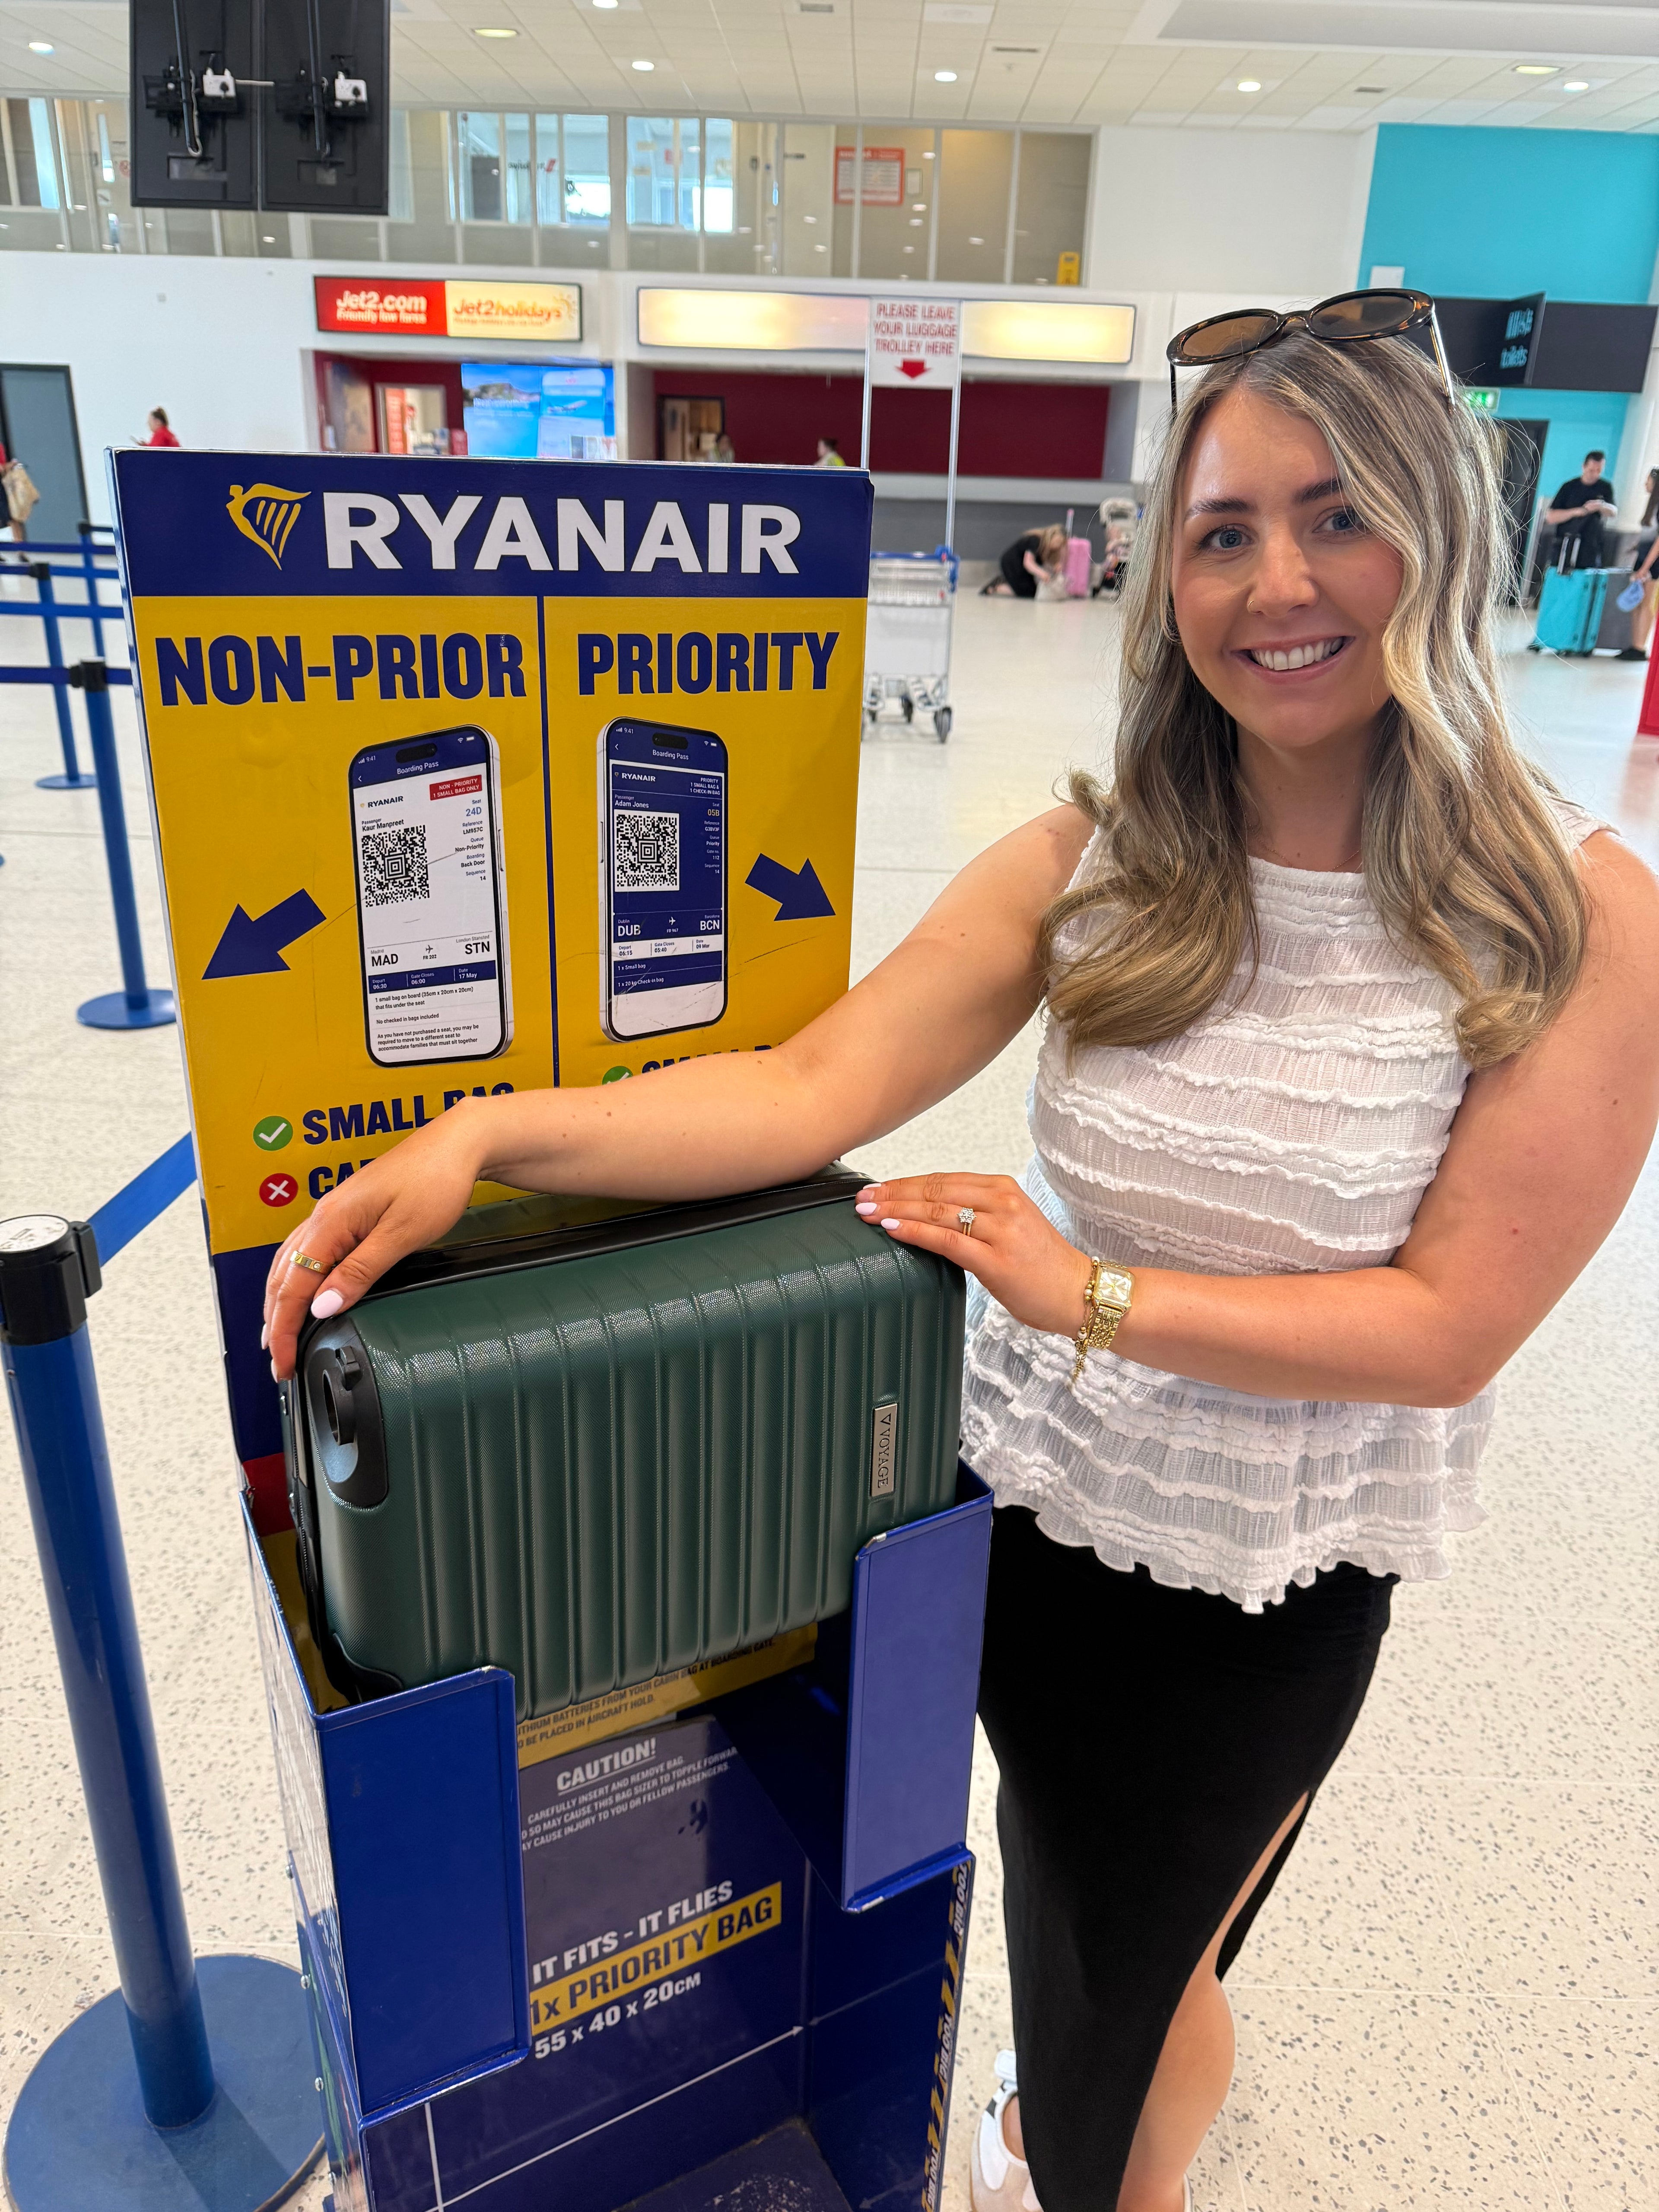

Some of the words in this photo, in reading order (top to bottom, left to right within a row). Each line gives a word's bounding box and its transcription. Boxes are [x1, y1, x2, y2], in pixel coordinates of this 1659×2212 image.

[336, 291, 427, 311] Jet2.com
[454, 299, 562, 321] Jet2holidays
[877, 303, 917, 318] PLEASE
[922, 305, 955, 320] LEAVE
[874, 321, 903, 335] YOUR
[906, 323, 958, 337] LUGGAGE
[875, 339, 922, 353] TROLLEY
[925, 341, 954, 355] HERE
[322, 492, 801, 574] RYANAIR
[155, 633, 527, 707] NON-PRIOR
[577, 630, 840, 697] PRIORITY
[653, 750, 675, 759] Boarding
[397, 765, 423, 774] Boarding
[622, 773, 656, 782] RYANAIR
[454, 779, 477, 788] PRIORITY
[368, 796, 404, 807] RYANAIR
[466, 807, 482, 817] 24D
[377, 820, 404, 830] Manpreet
[455, 843, 484, 852] Non-Priority
[618, 925, 641, 936] DUB
[700, 920, 720, 930] BCN
[465, 941, 490, 954] STN
[372, 954, 398, 966] MAD
[303, 1095, 435, 1145] SMALL
[557, 1737, 656, 1791] CAUTION!
[528, 1798, 577, 1824] CAREFULLY
[578, 1785, 610, 1805] INSERT
[611, 1778, 629, 1792] AND
[630, 1762, 665, 1785] REMOVE
[666, 1756, 683, 1770] BAG
[957, 1863, 967, 1901] TOO
[953, 1901, 963, 1936] BIG
[533, 1956, 558, 1983] IT
[564, 1930, 619, 1971] FITS
[624, 1930, 633, 1939] -
[639, 1910, 663, 1937] IT
[668, 1880, 733, 1925] FLIES
[531, 1996, 560, 2026] 1x
[569, 1924, 709, 2009] PRIORITY
[718, 1897, 772, 1942] BAG
[535, 2030, 566, 2059] 55
[572, 2028, 584, 2044] x
[589, 2005, 620, 2031] 40
[626, 2001, 638, 2018] x
